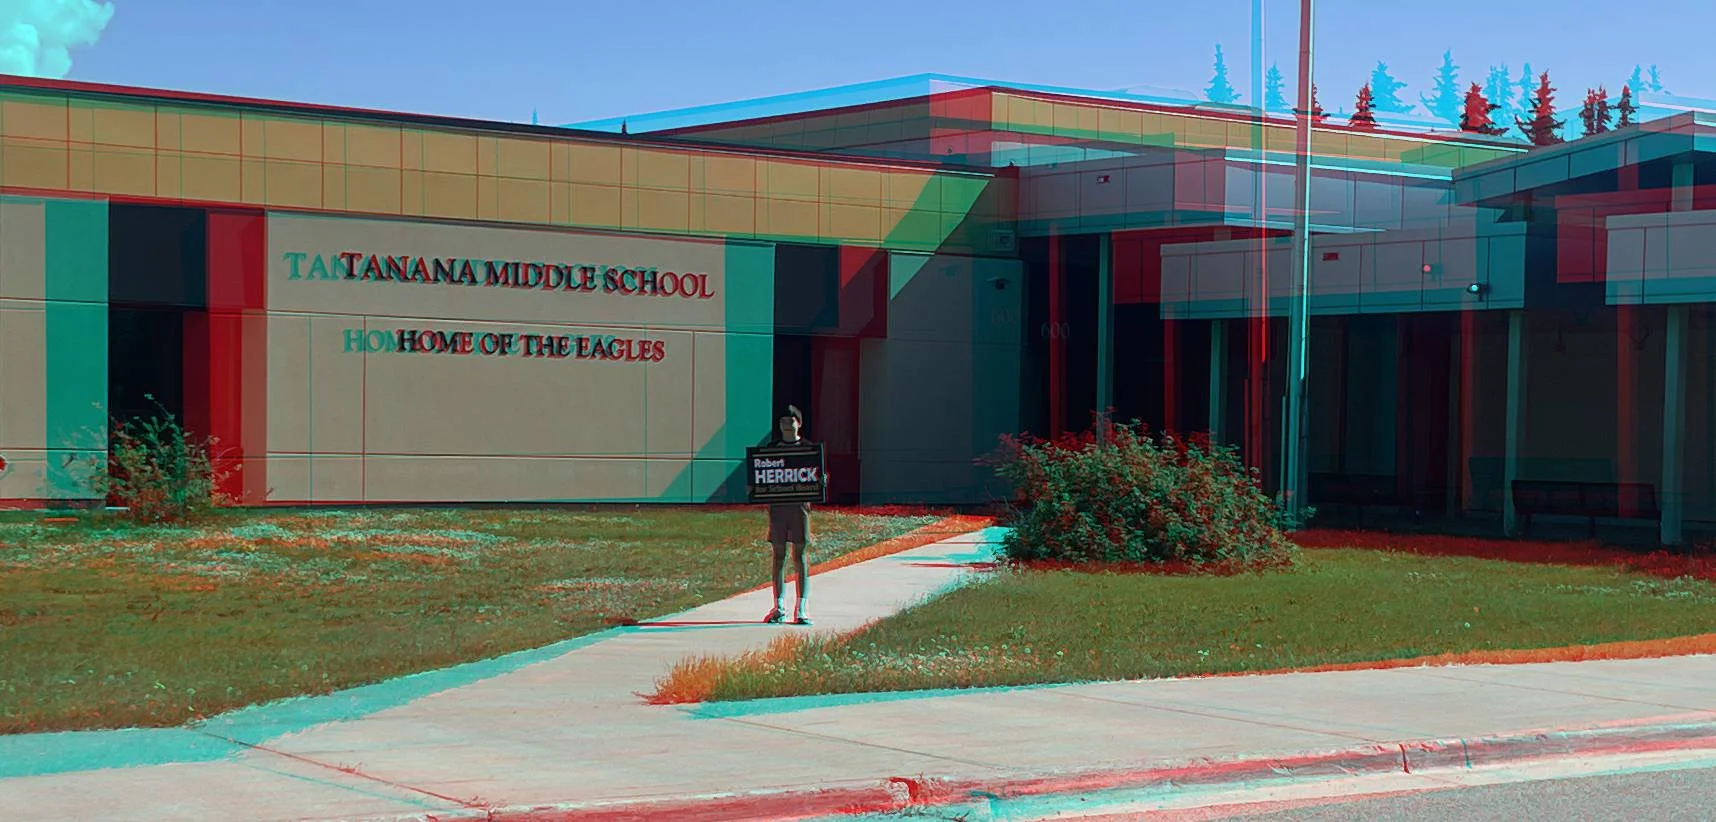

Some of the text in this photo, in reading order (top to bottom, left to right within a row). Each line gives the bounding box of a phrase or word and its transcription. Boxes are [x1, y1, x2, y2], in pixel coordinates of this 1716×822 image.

[340, 252, 715, 299] TANANA MIDDLE SCHOOL
[396, 329, 666, 362] HOME OF THE EAGLES
[754, 458, 785, 468] Robert
[754, 467, 818, 484] HERRICK
